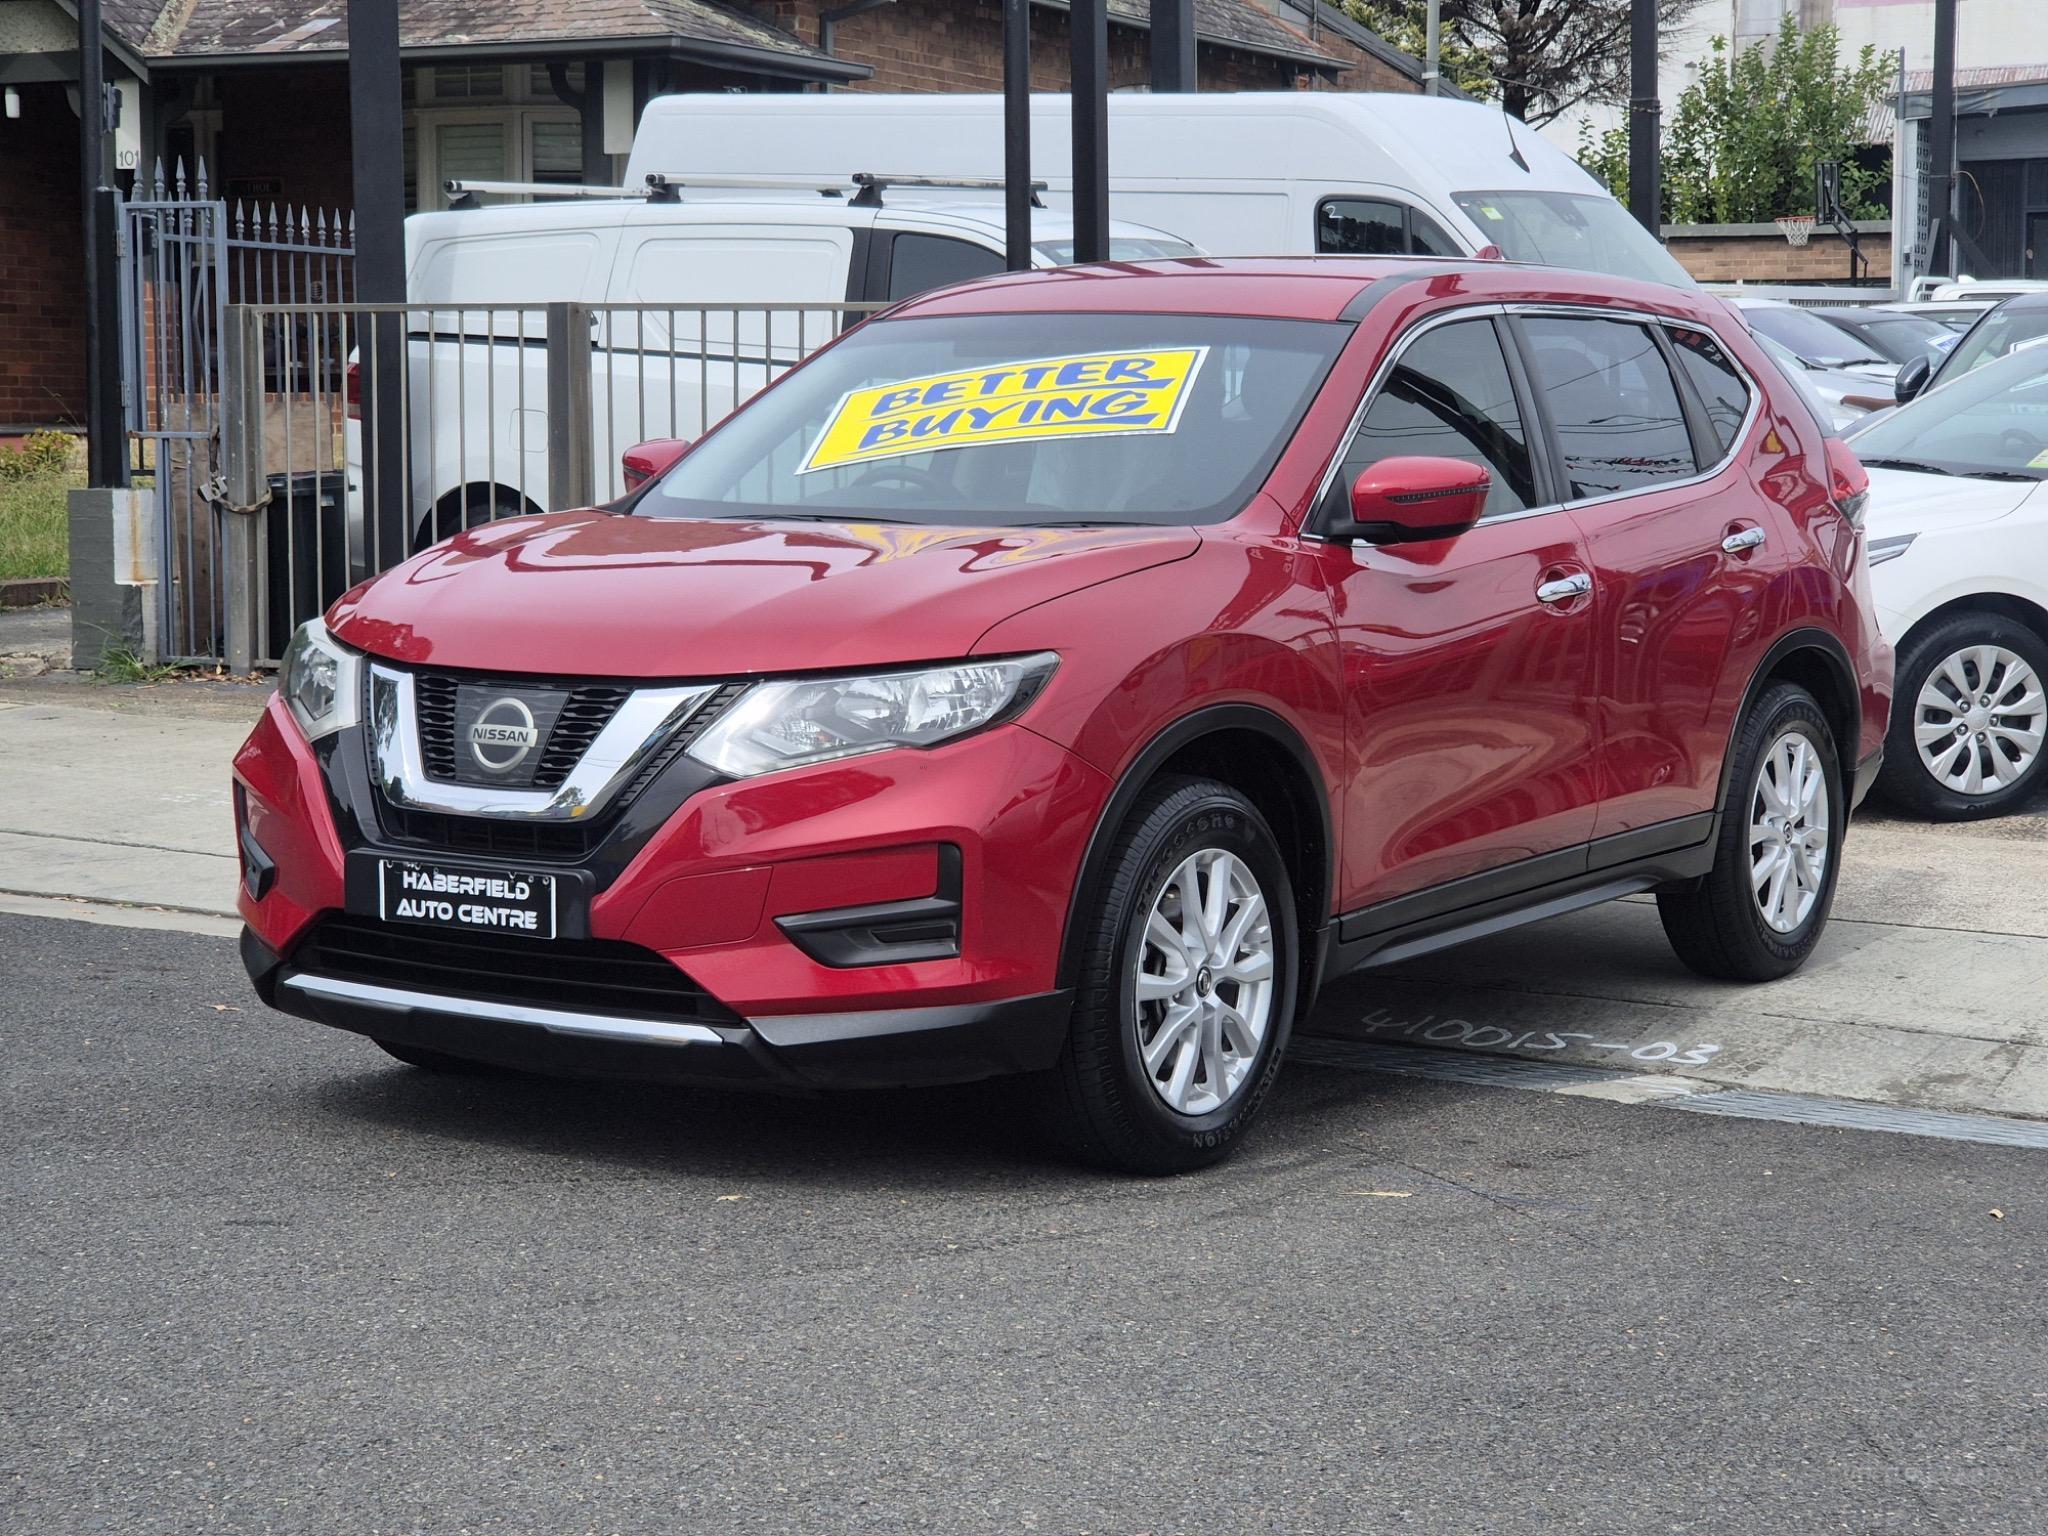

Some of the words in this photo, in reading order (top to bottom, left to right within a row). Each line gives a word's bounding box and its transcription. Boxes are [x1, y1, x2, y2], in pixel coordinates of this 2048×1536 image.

[871, 358, 1156, 417] BETTER
[858, 390, 1149, 450] BUYING
[472, 727, 529, 743] NISSAN
[402, 870, 530, 900] HABERFIELD
[396, 897, 453, 921] AUTO
[457, 904, 538, 930] CENTRE
